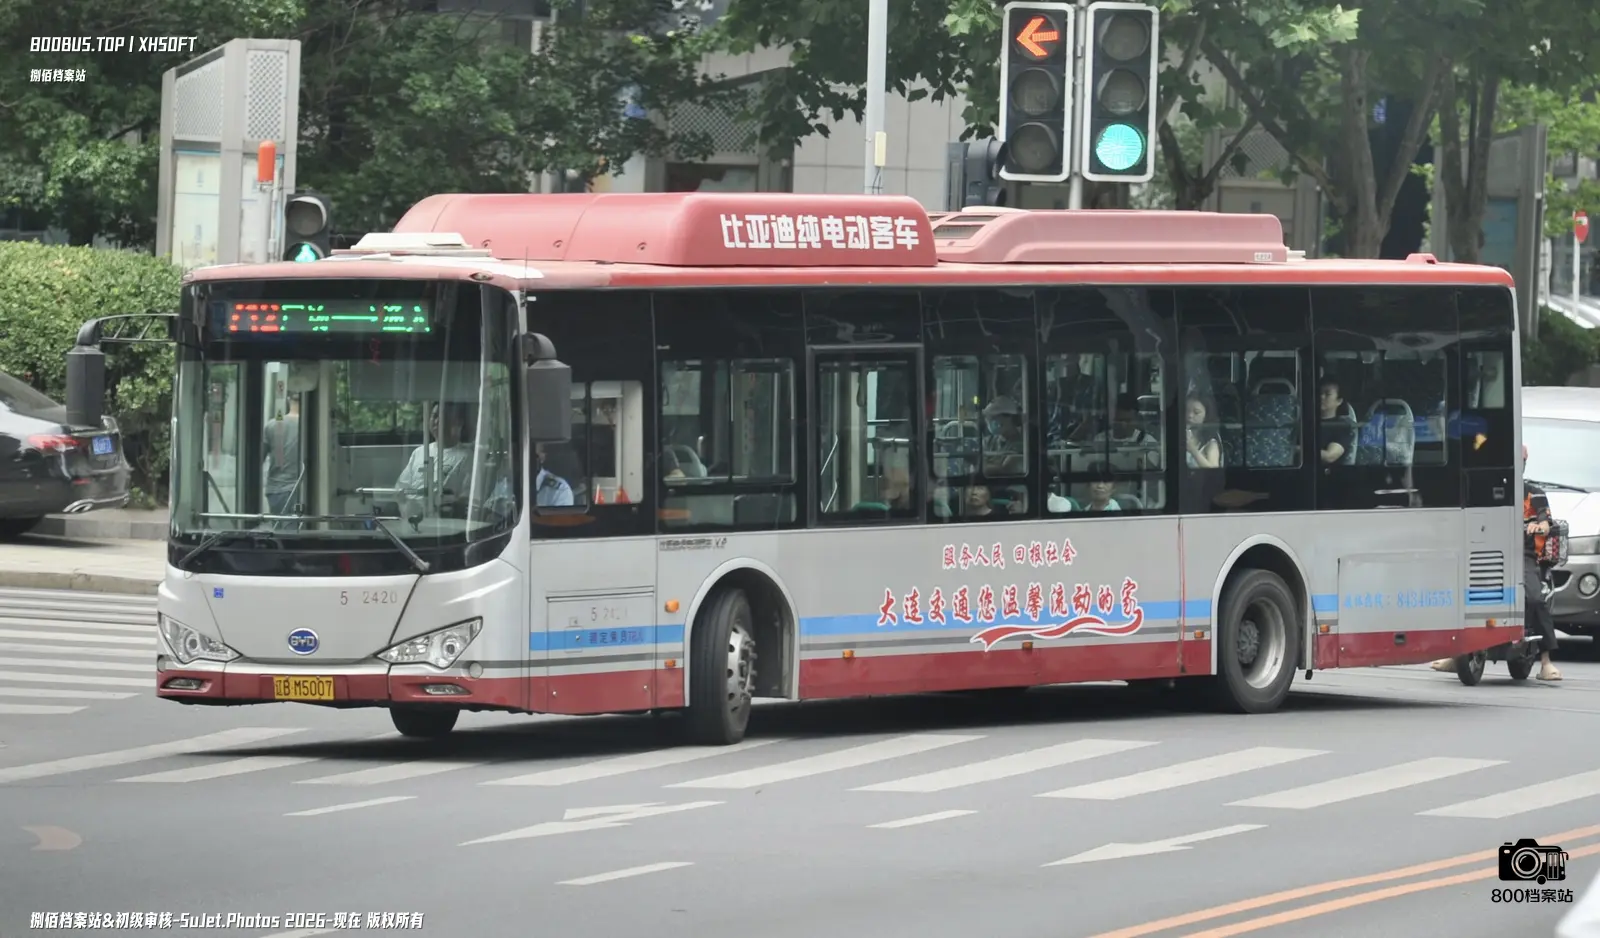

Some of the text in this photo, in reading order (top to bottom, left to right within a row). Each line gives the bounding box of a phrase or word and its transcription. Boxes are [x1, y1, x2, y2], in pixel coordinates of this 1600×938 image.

[719, 213, 920, 250] 比亚迪纯电动客车
[942, 538, 1078, 570] 服务人民 回报社会
[362, 590, 398, 604] 2420
[877, 577, 1143, 626] 大连交通您温馨流动的家
